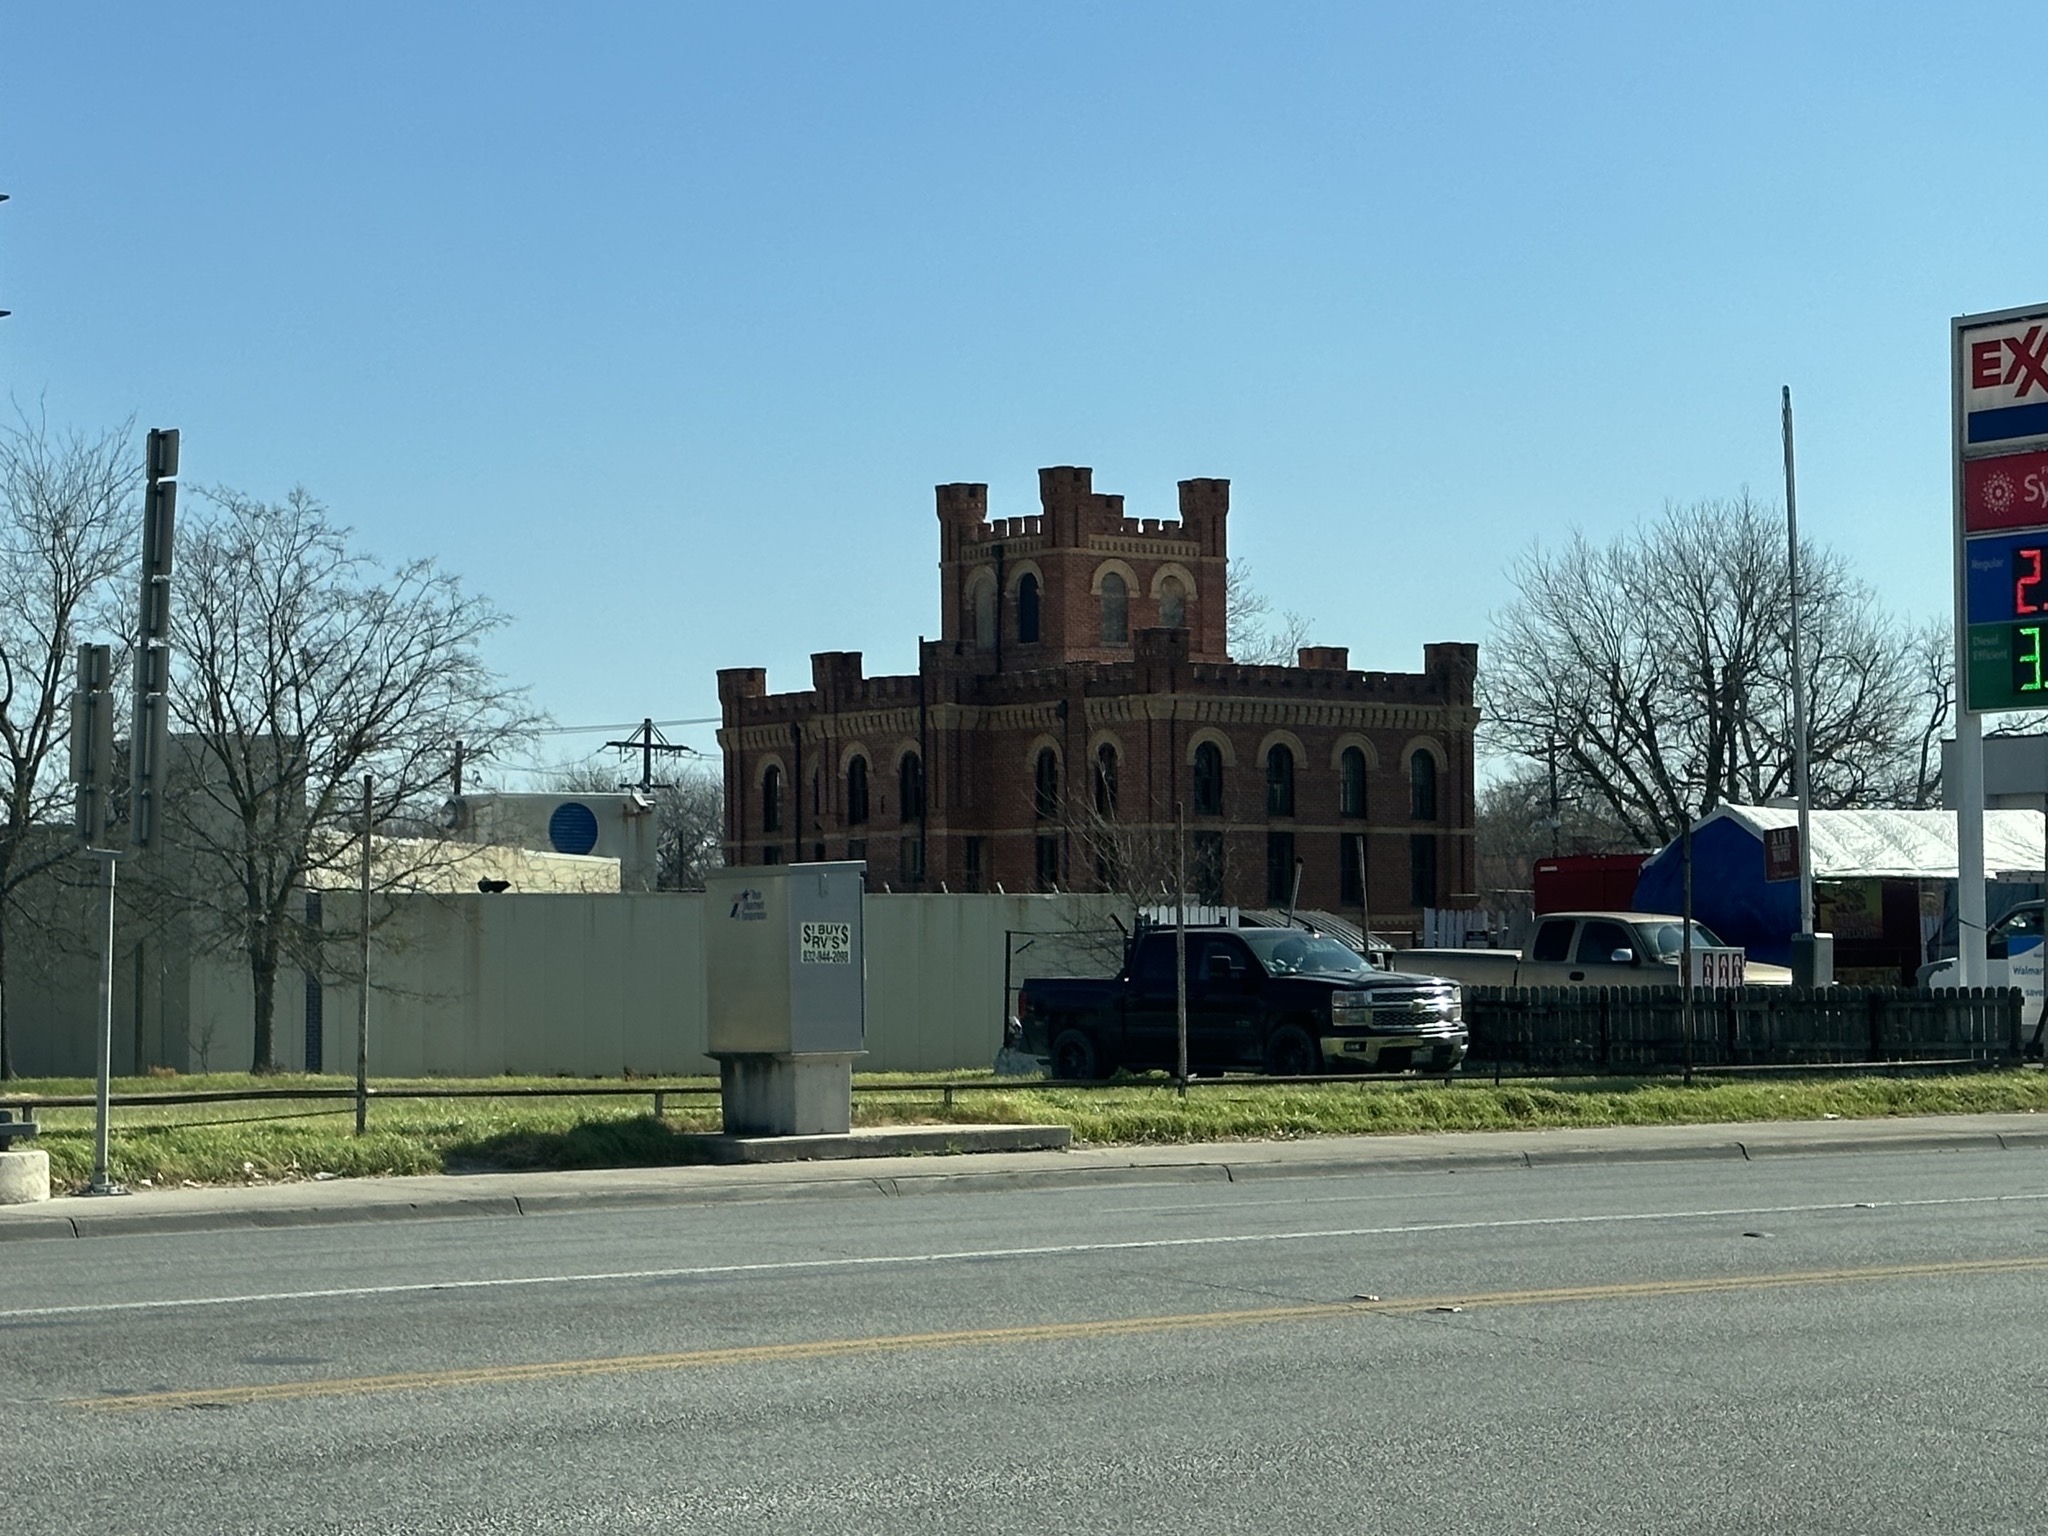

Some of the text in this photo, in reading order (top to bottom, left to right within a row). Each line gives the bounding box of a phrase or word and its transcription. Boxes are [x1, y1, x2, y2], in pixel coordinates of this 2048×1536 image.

[1971, 557, 2004, 572] Regular
[1973, 634, 1999, 647] Diesel
[1772, 830, 1790, 846] AIR
[818, 924, 840, 935] BUY
[2013, 965, 2044, 976] Walmar
